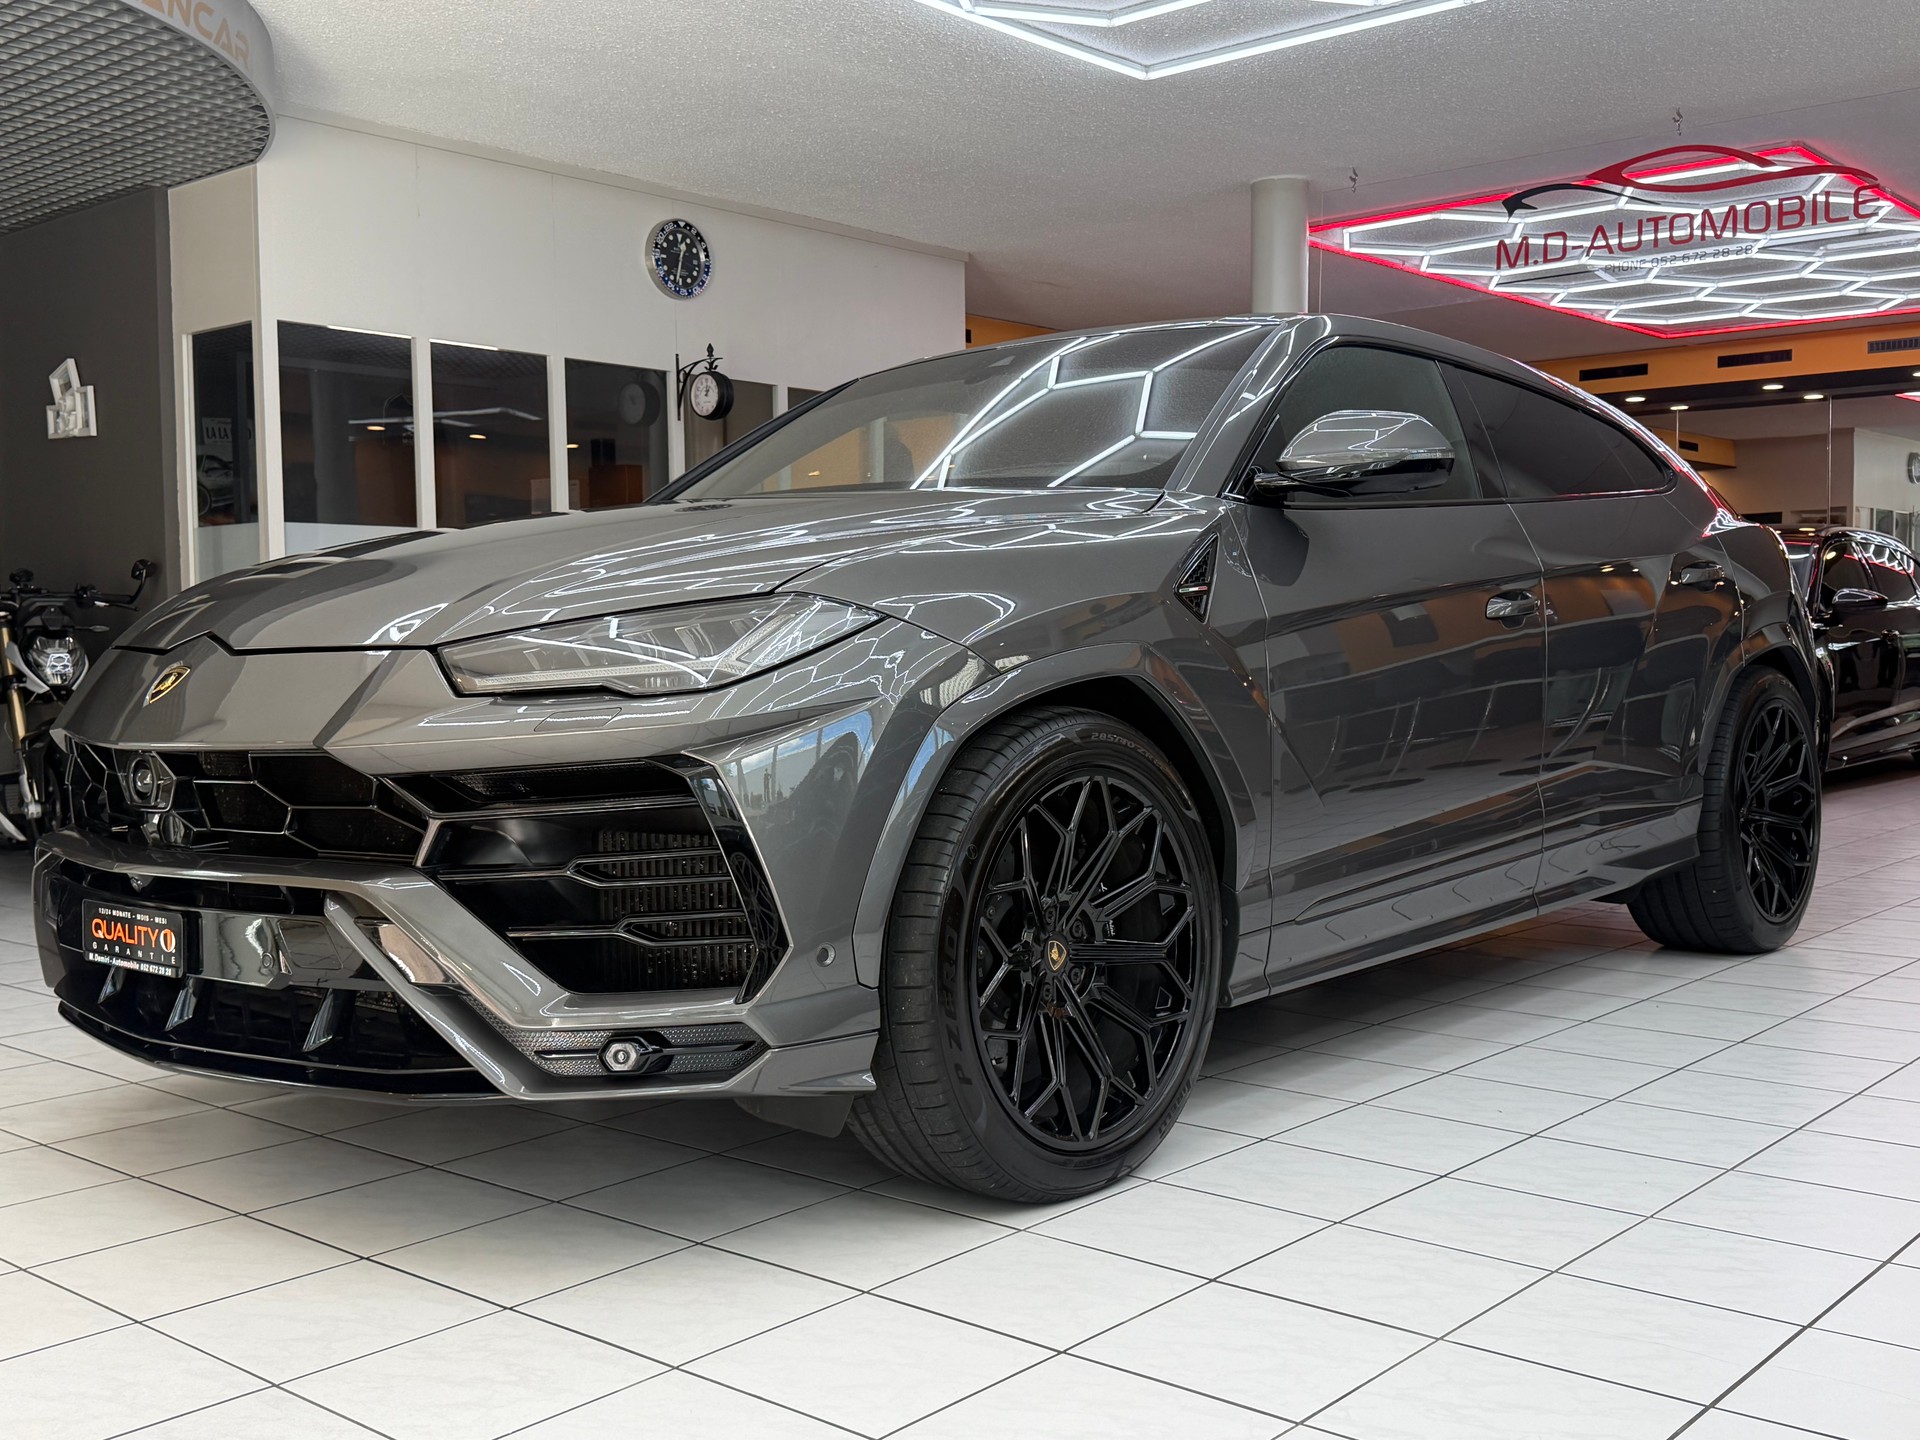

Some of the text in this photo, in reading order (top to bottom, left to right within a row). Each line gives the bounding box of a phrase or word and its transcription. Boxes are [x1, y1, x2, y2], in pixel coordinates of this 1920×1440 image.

[1495, 183, 1881, 271] M.D-AUTOMOBILE
[1604, 244, 1754, 274] PHONE 052 672 28 28
[91, 918, 159, 948] QUALITY
[92, 941, 176, 965] GARANTIE
